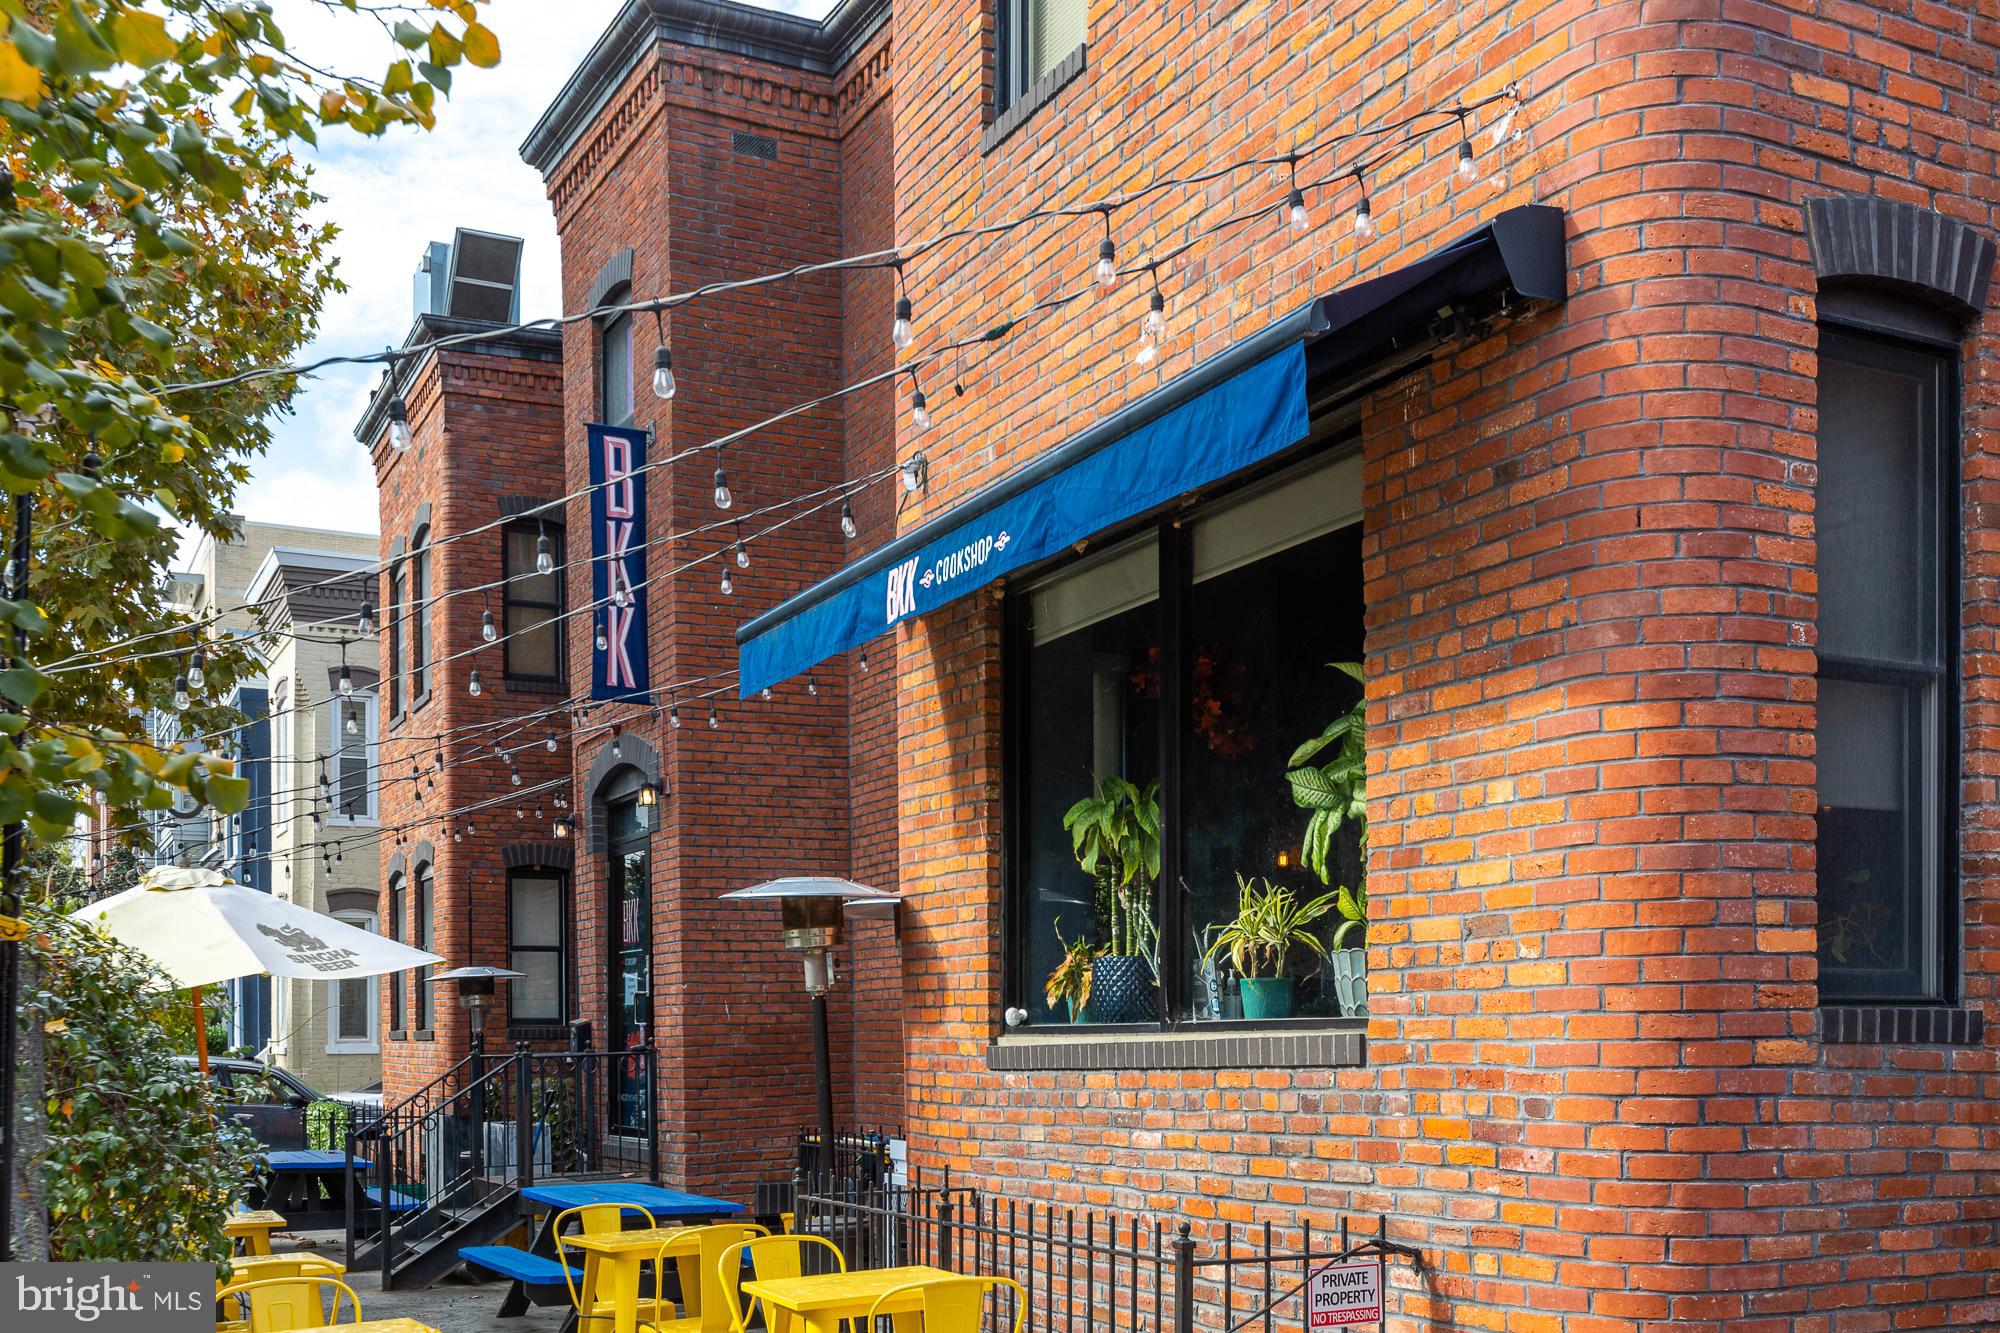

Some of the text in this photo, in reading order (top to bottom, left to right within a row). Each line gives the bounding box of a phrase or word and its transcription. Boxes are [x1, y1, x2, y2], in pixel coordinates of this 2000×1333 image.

[603, 434, 637, 689] BKK
[886, 535, 993, 625] BKK COOKSHOP
[622, 898, 640, 945] BKK
[286, 948, 360, 964] SINGHA
[311, 959, 360, 972] BEER
[1322, 1271, 1369, 1288] PRIVATE
[1315, 1288, 1376, 1307] PROPERTY
[1313, 1308, 1379, 1325] NO TRESPASSING
